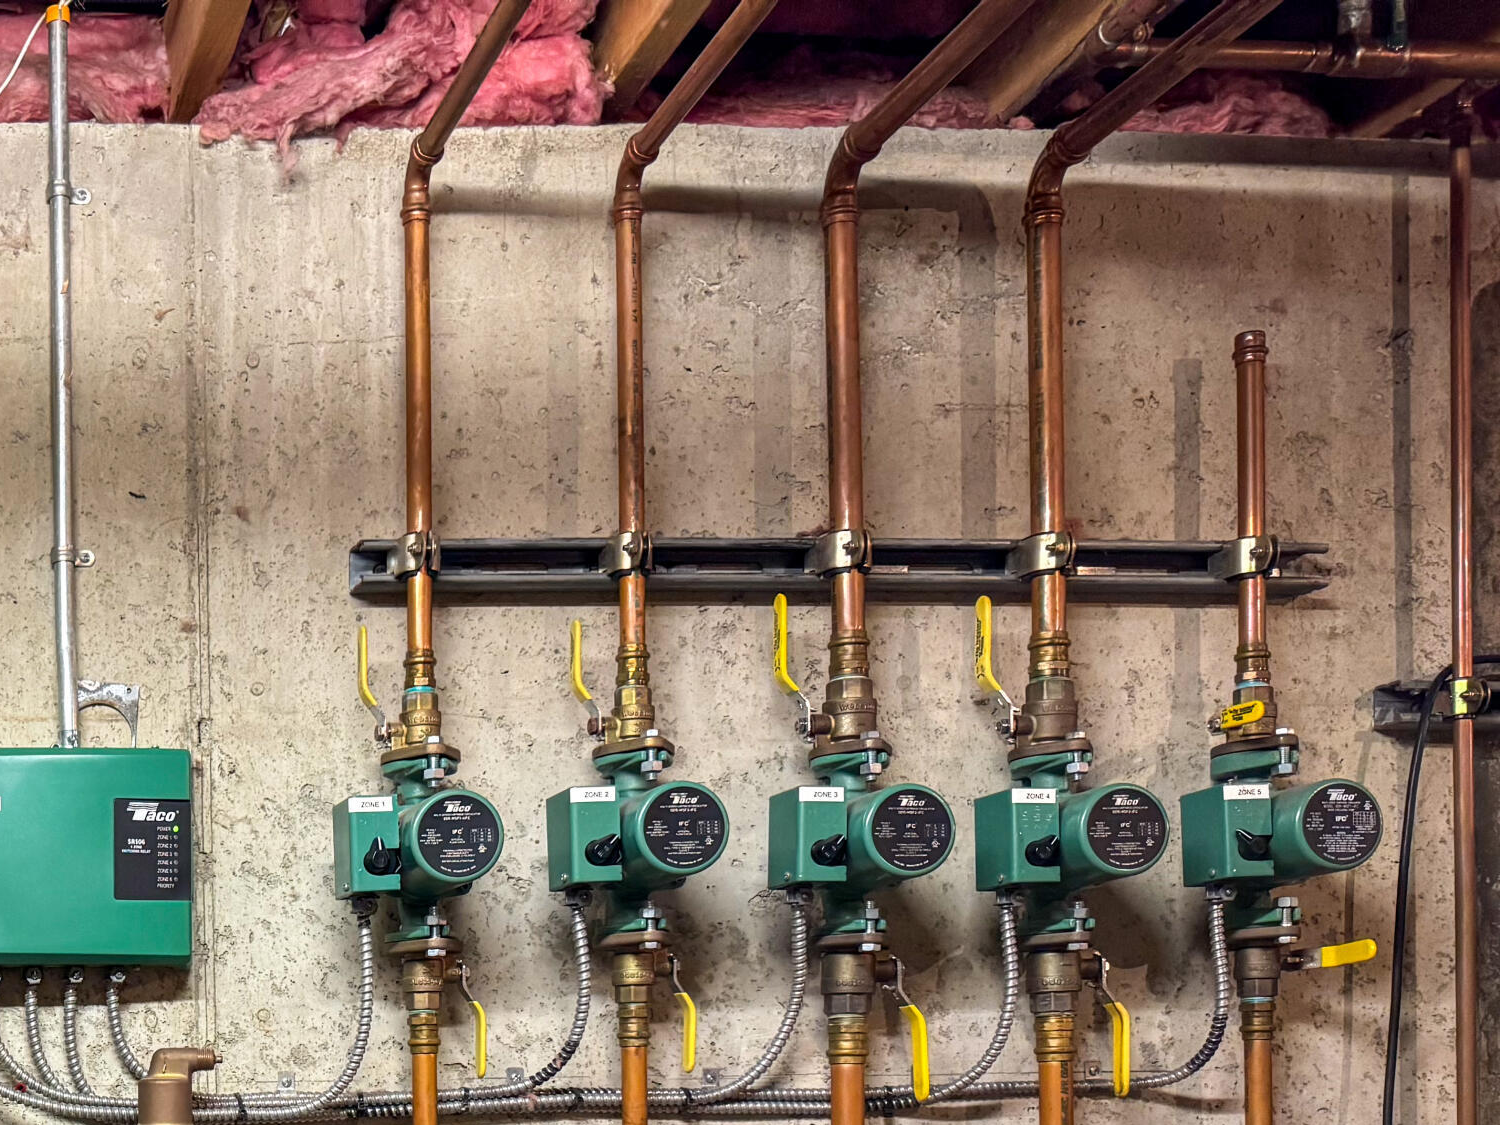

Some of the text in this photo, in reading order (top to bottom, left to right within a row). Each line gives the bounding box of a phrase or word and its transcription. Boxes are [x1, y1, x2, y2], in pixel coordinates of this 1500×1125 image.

[670, 793, 698, 804] Taco
[1112, 794, 1138, 806] Taco
[1327, 788, 1355, 801] Taco
[444, 800, 471, 813] Taco
[897, 795, 925, 807] Taco
[127, 802, 176, 822] Taco
